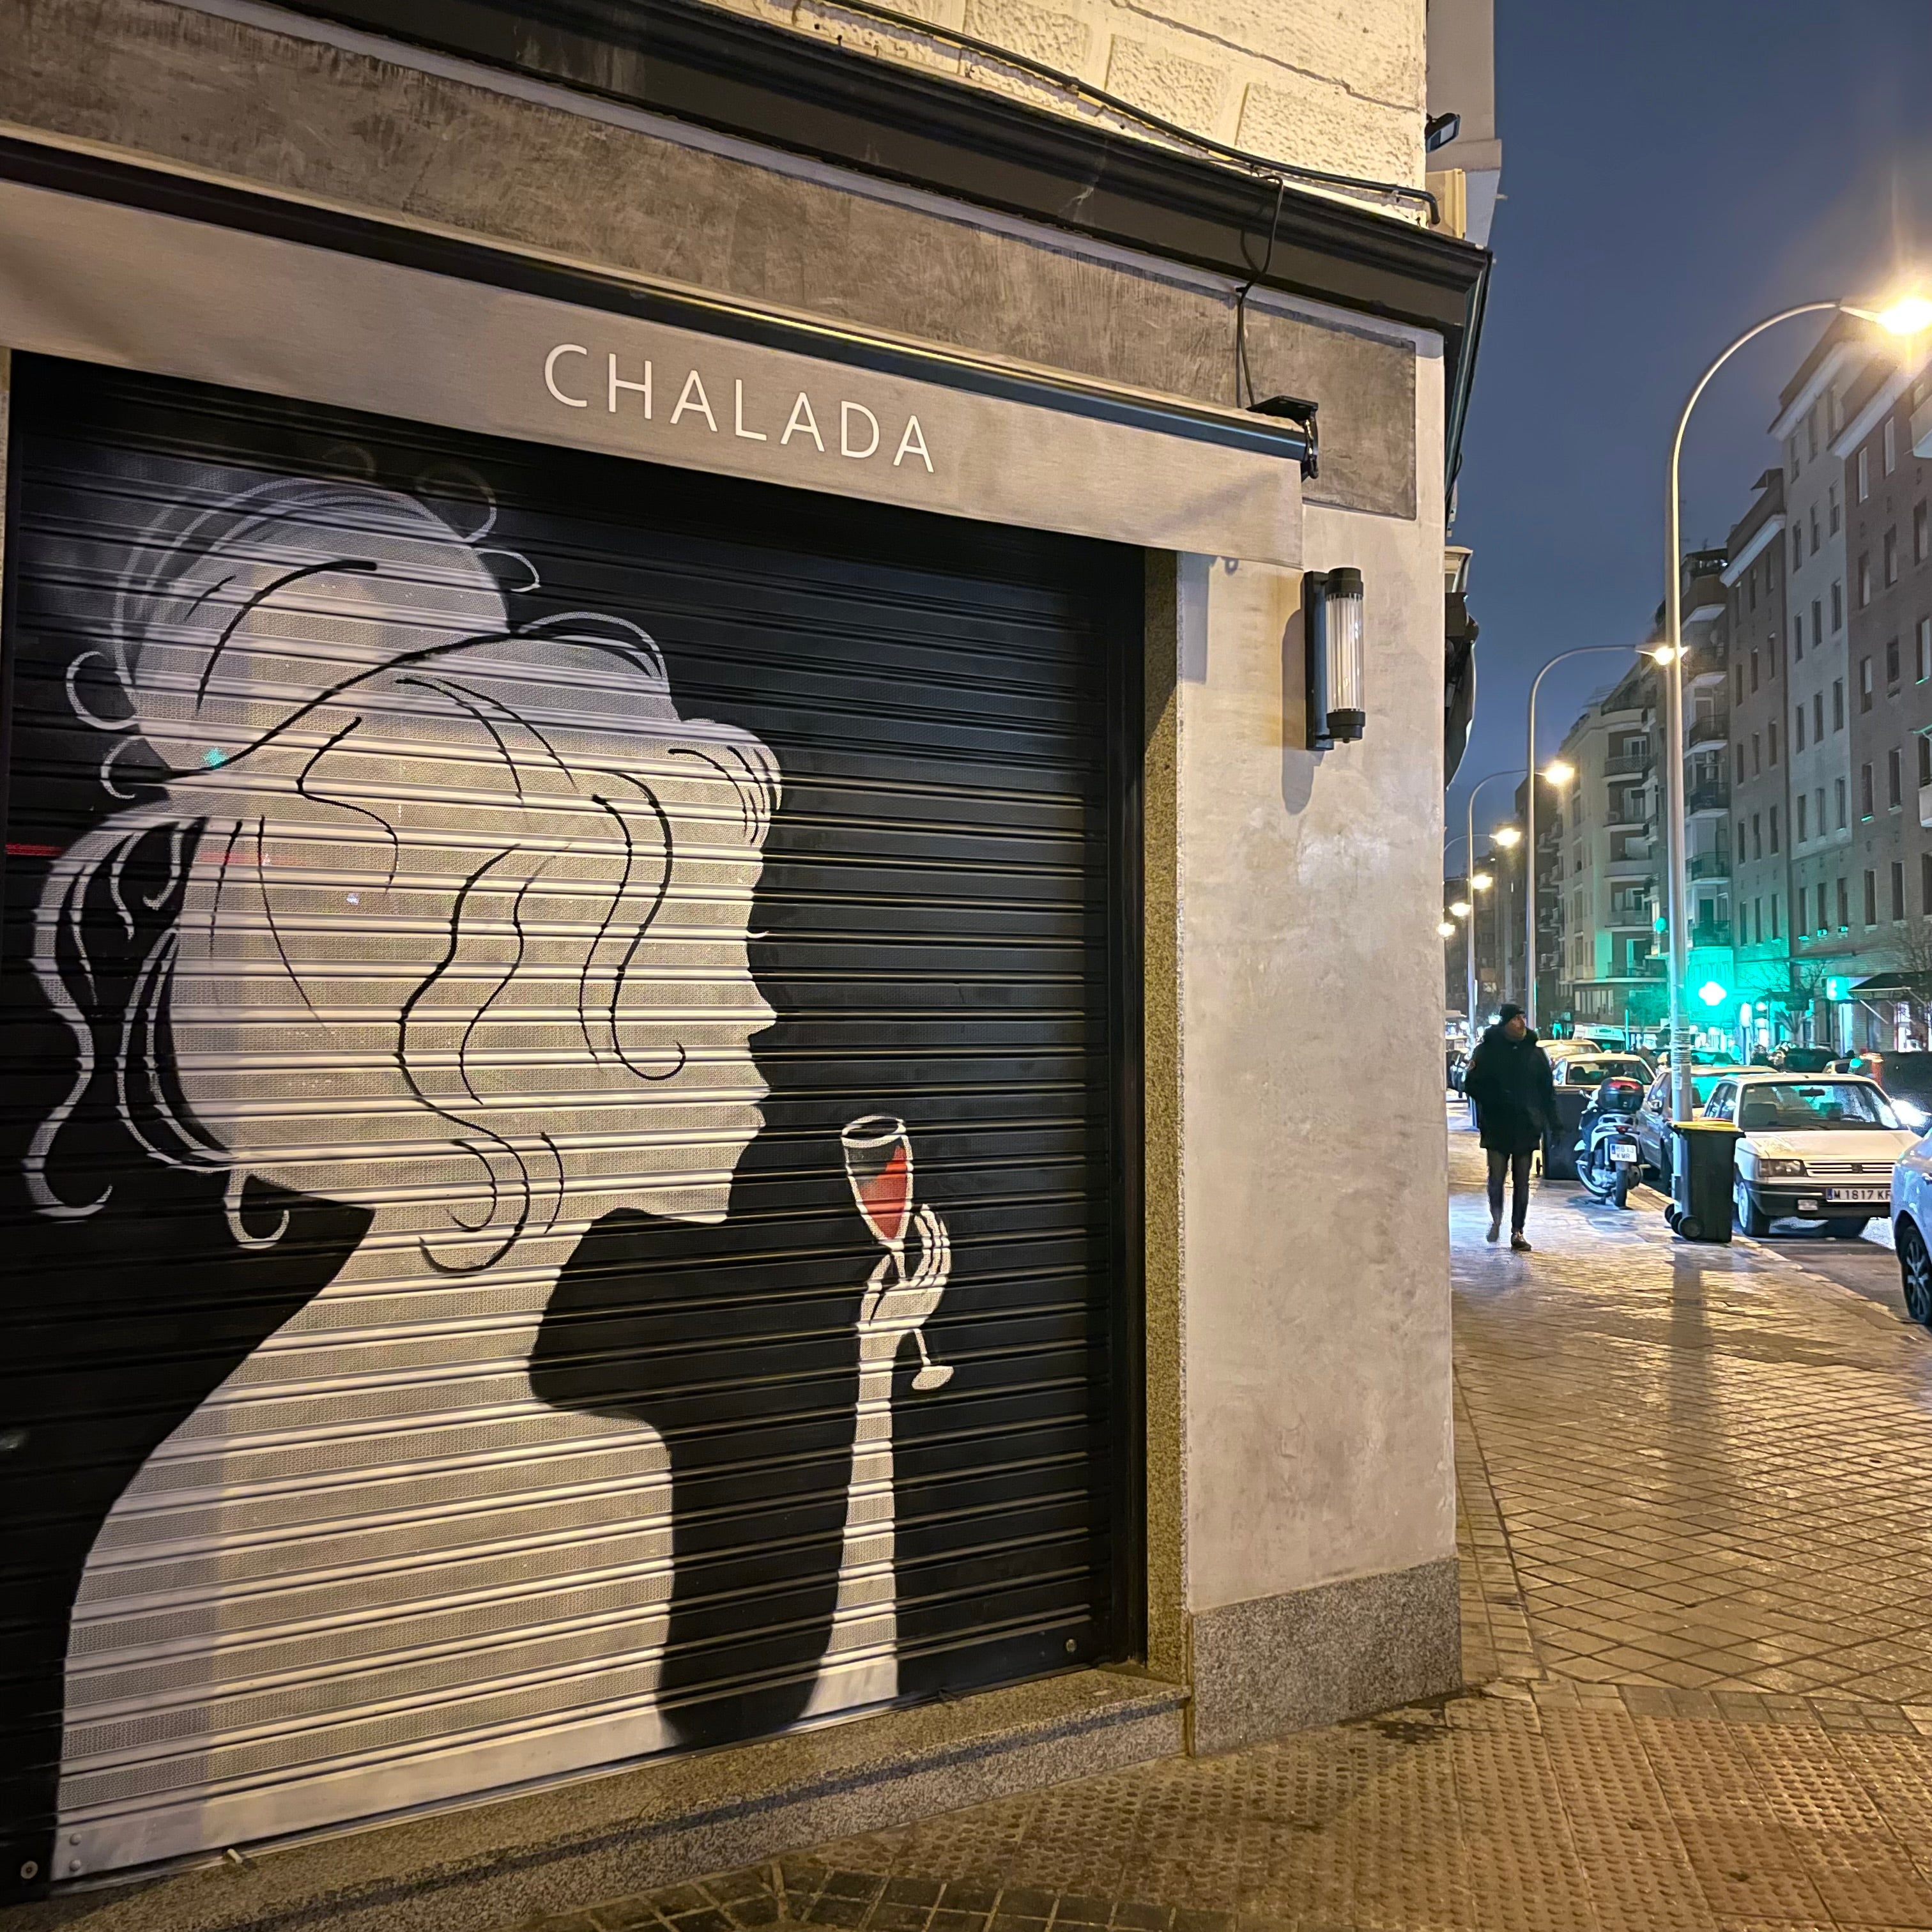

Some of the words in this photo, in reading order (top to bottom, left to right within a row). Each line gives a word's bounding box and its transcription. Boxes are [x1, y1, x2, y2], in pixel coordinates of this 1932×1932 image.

[544, 343, 935, 473] CHALADA
[1834, 1190, 1841, 1200] M
[1844, 1190, 1874, 1200] 1817
